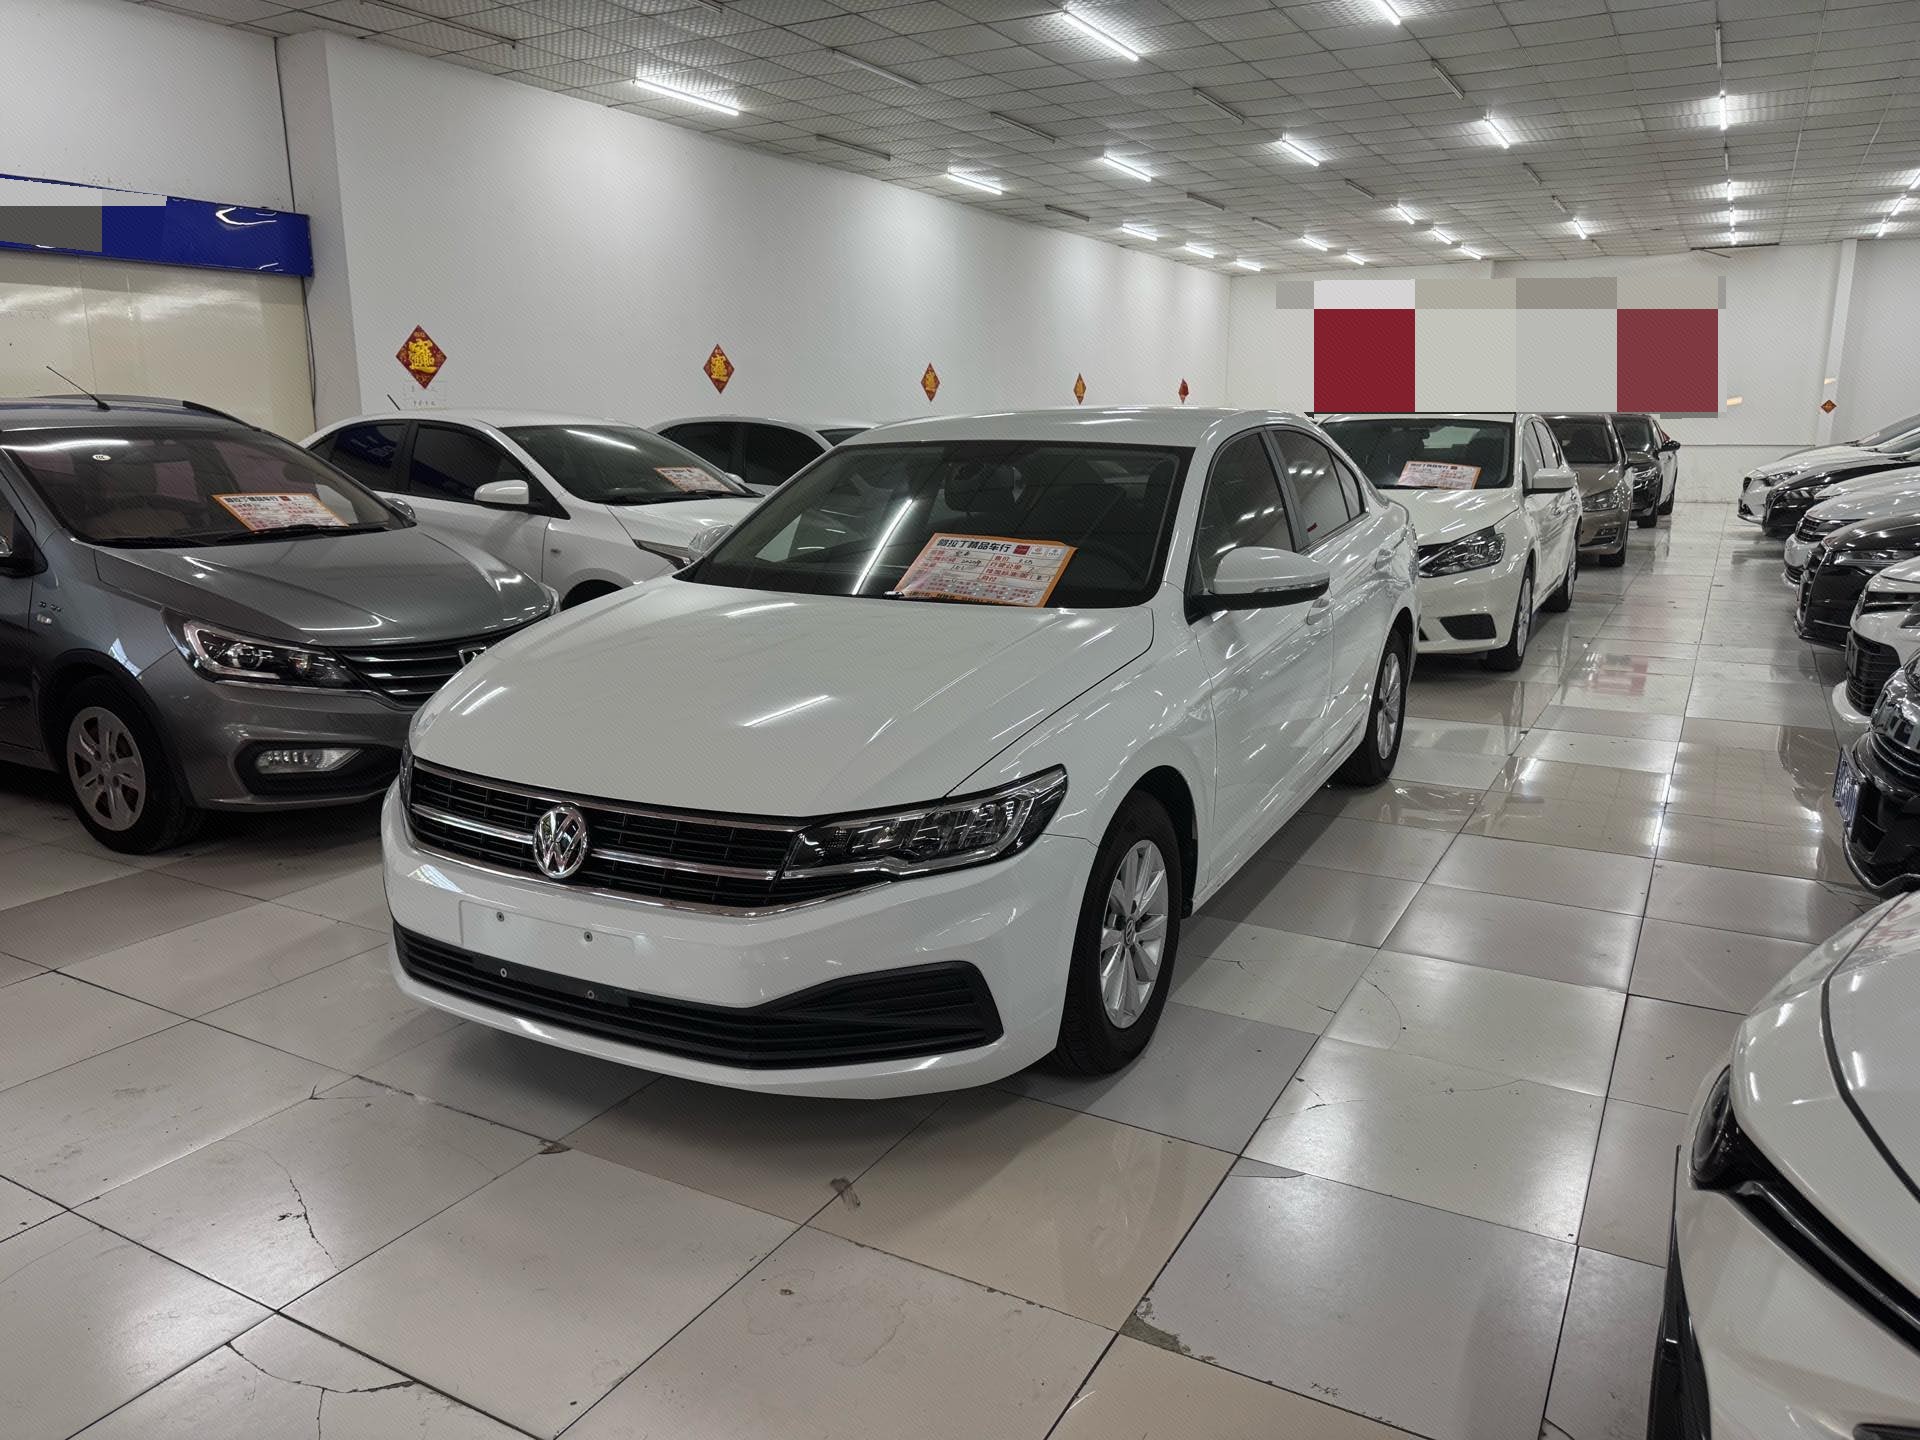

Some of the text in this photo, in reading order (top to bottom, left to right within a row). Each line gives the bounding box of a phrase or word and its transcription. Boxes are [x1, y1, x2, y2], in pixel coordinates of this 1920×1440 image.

[937, 539, 1012, 553] 阿拉丁精品车行
